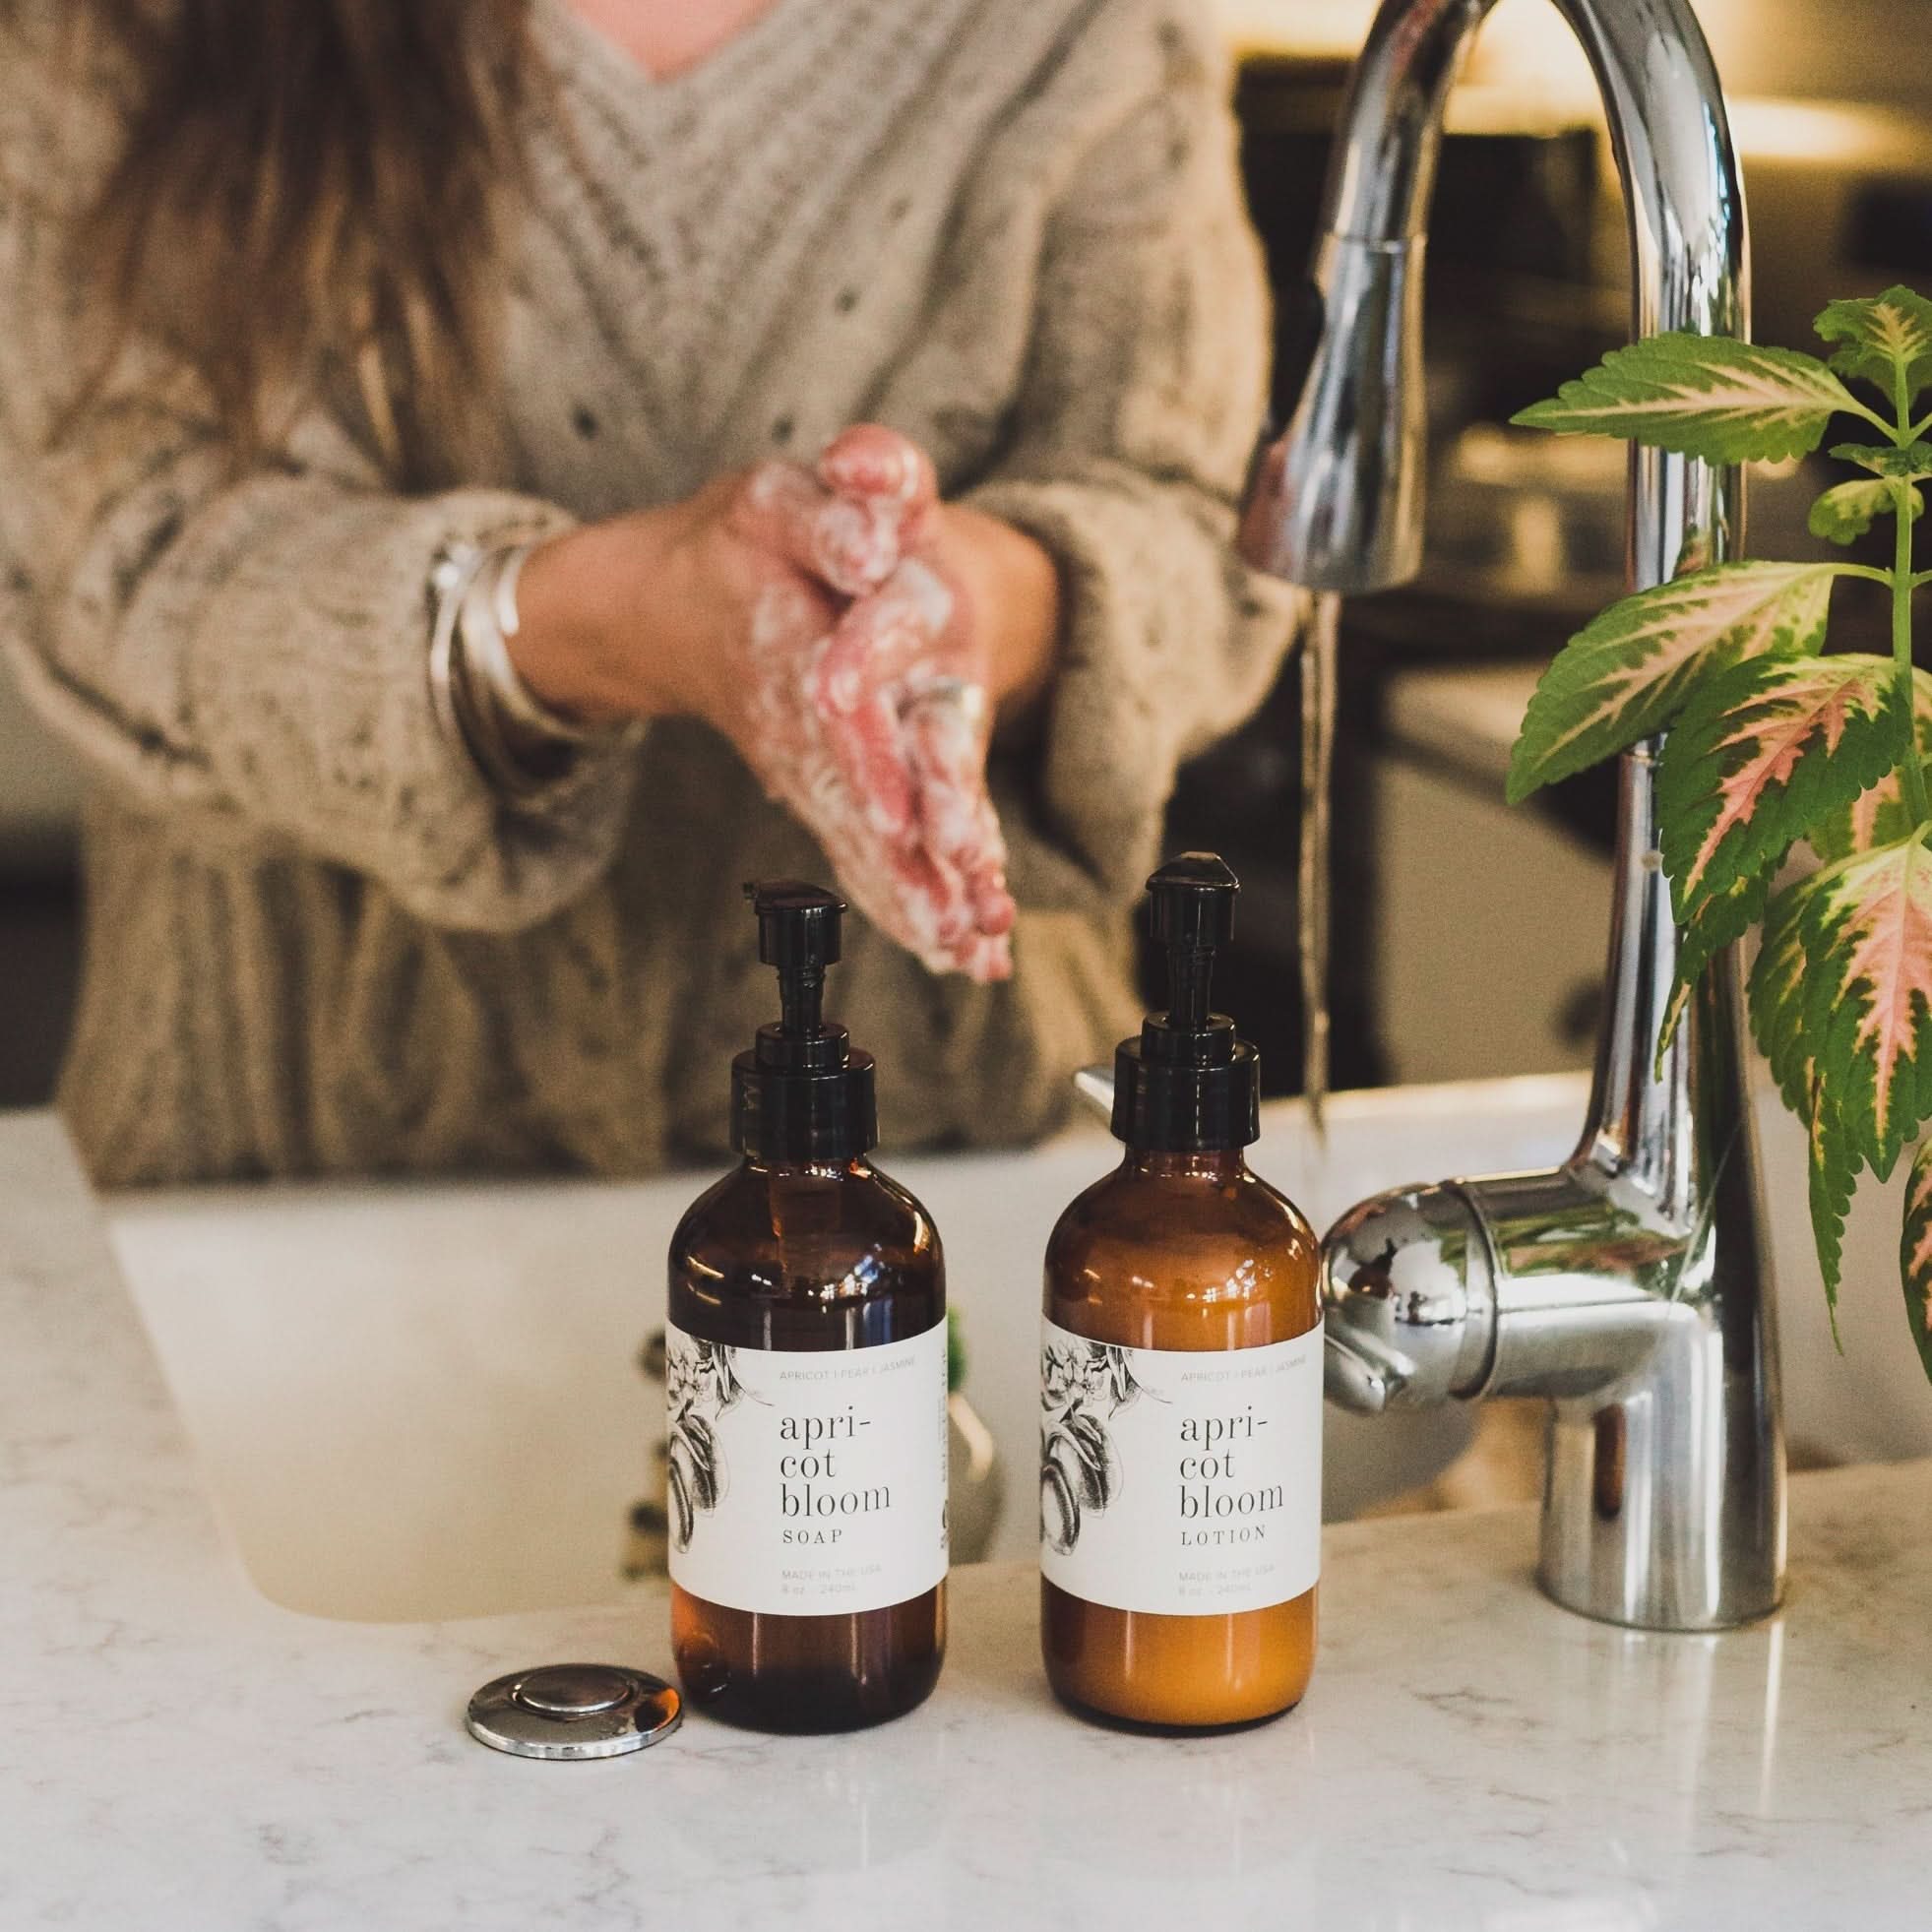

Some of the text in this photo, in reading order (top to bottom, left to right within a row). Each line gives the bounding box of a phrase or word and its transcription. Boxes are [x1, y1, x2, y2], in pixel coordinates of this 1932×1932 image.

[779, 1369, 829, 1381] APRICOT
[1180, 1369, 1229, 1383] APRICOT
[1240, 1364, 1268, 1380] PEAR
[779, 1404, 871, 1451] apri-
[1180, 1404, 1269, 1452] apri-
[779, 1448, 836, 1479] cot
[1179, 1448, 1235, 1480] cot
[779, 1482, 891, 1518] bloom
[1178, 1484, 1283, 1519] bloom
[782, 1528, 842, 1544] SOAP
[1181, 1525, 1266, 1546] LOTION
